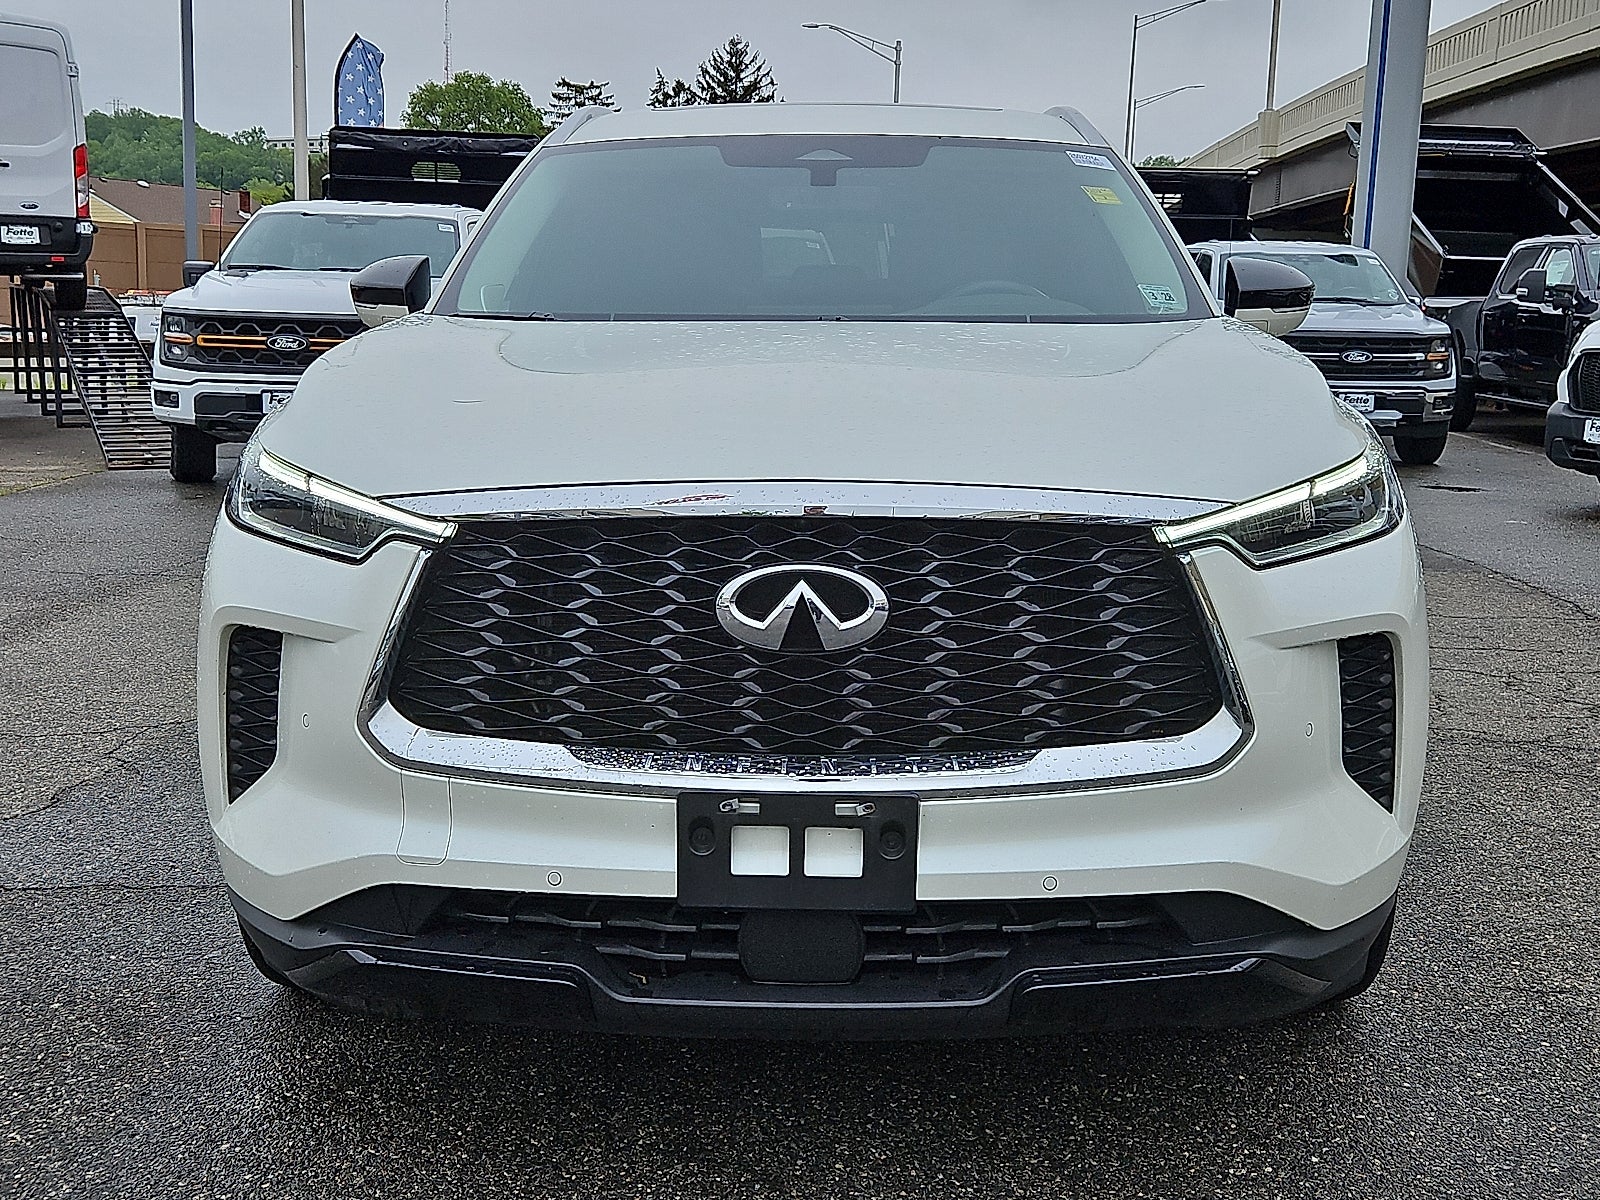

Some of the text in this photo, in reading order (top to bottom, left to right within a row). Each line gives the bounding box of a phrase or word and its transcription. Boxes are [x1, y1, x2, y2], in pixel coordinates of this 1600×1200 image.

[1148, 291, 1158, 300] 3
[273, 337, 301, 349] Ford
[645, 753, 959, 774] INFINITI
